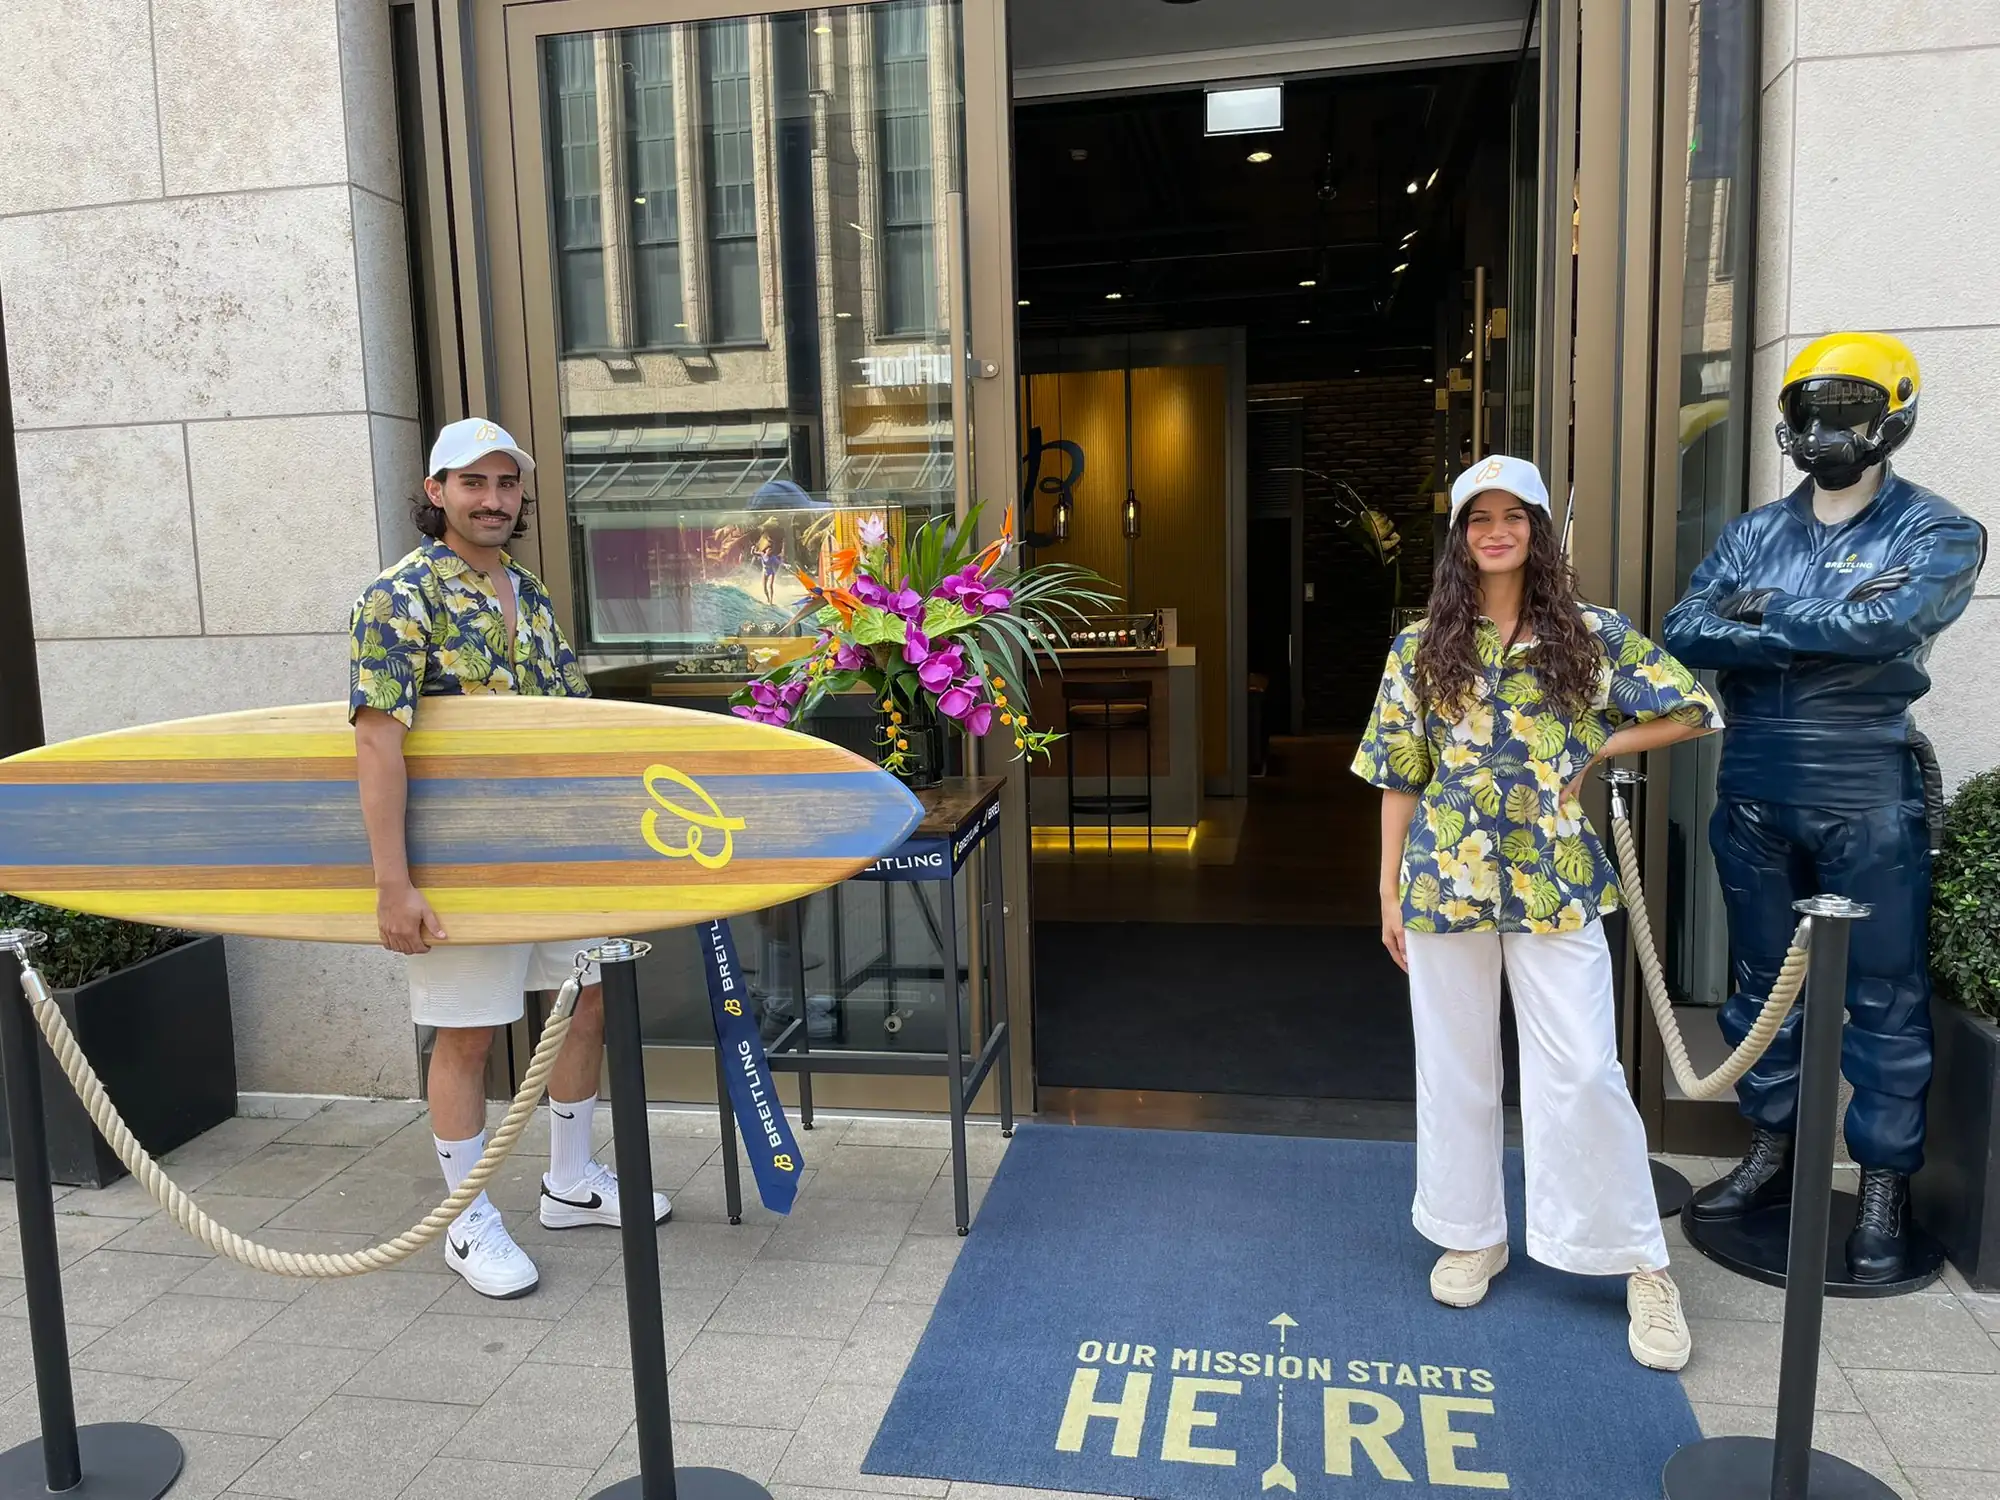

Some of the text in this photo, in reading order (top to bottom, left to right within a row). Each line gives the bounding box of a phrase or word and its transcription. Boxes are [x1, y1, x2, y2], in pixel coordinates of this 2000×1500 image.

[1824, 561, 1874, 569] BREITLING
[864, 853, 943, 872] ITLING
[738, 1040, 783, 1148] BREITLING
[1077, 1340, 1496, 1393] OUR MISSION STARTS
